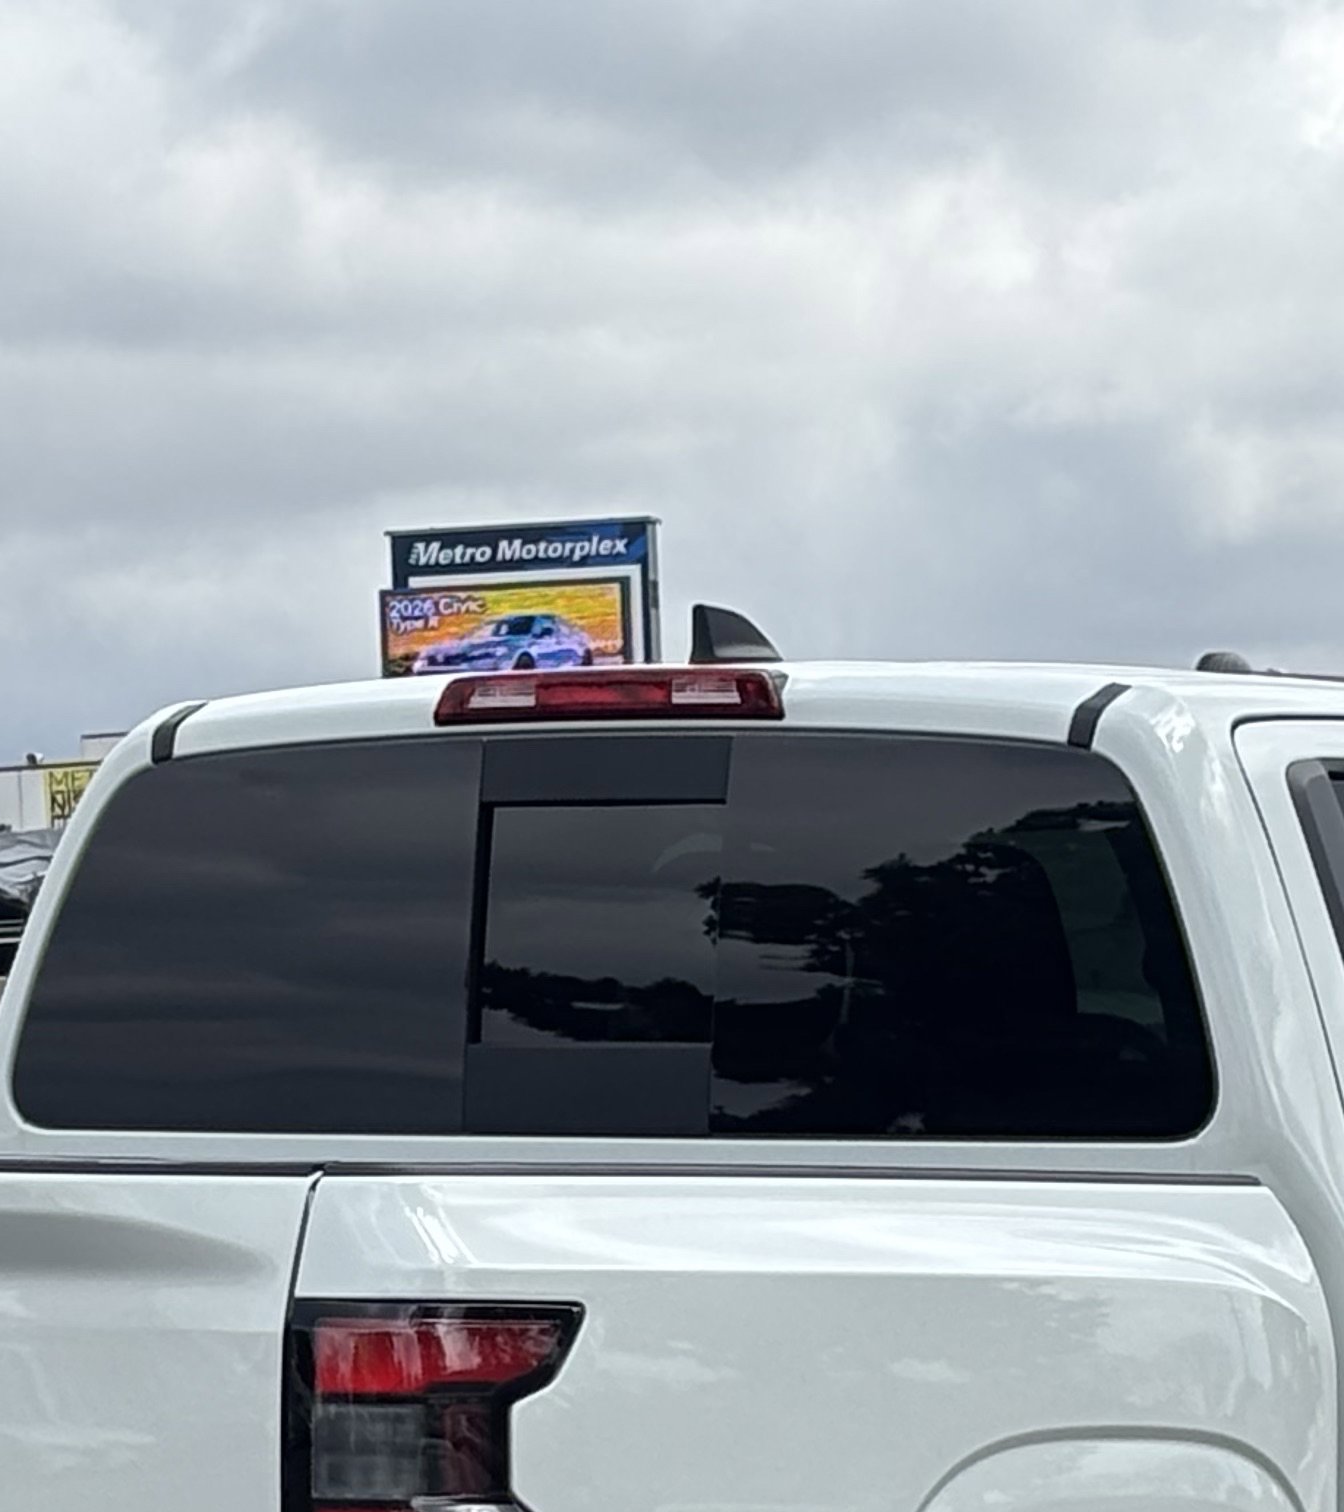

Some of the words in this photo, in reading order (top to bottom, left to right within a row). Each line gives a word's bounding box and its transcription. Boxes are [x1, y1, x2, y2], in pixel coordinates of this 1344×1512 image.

[415, 540, 492, 566] Metro
[496, 535, 629, 562] Motorplex
[389, 599, 435, 617] 2026
[439, 597, 486, 615] Civic
